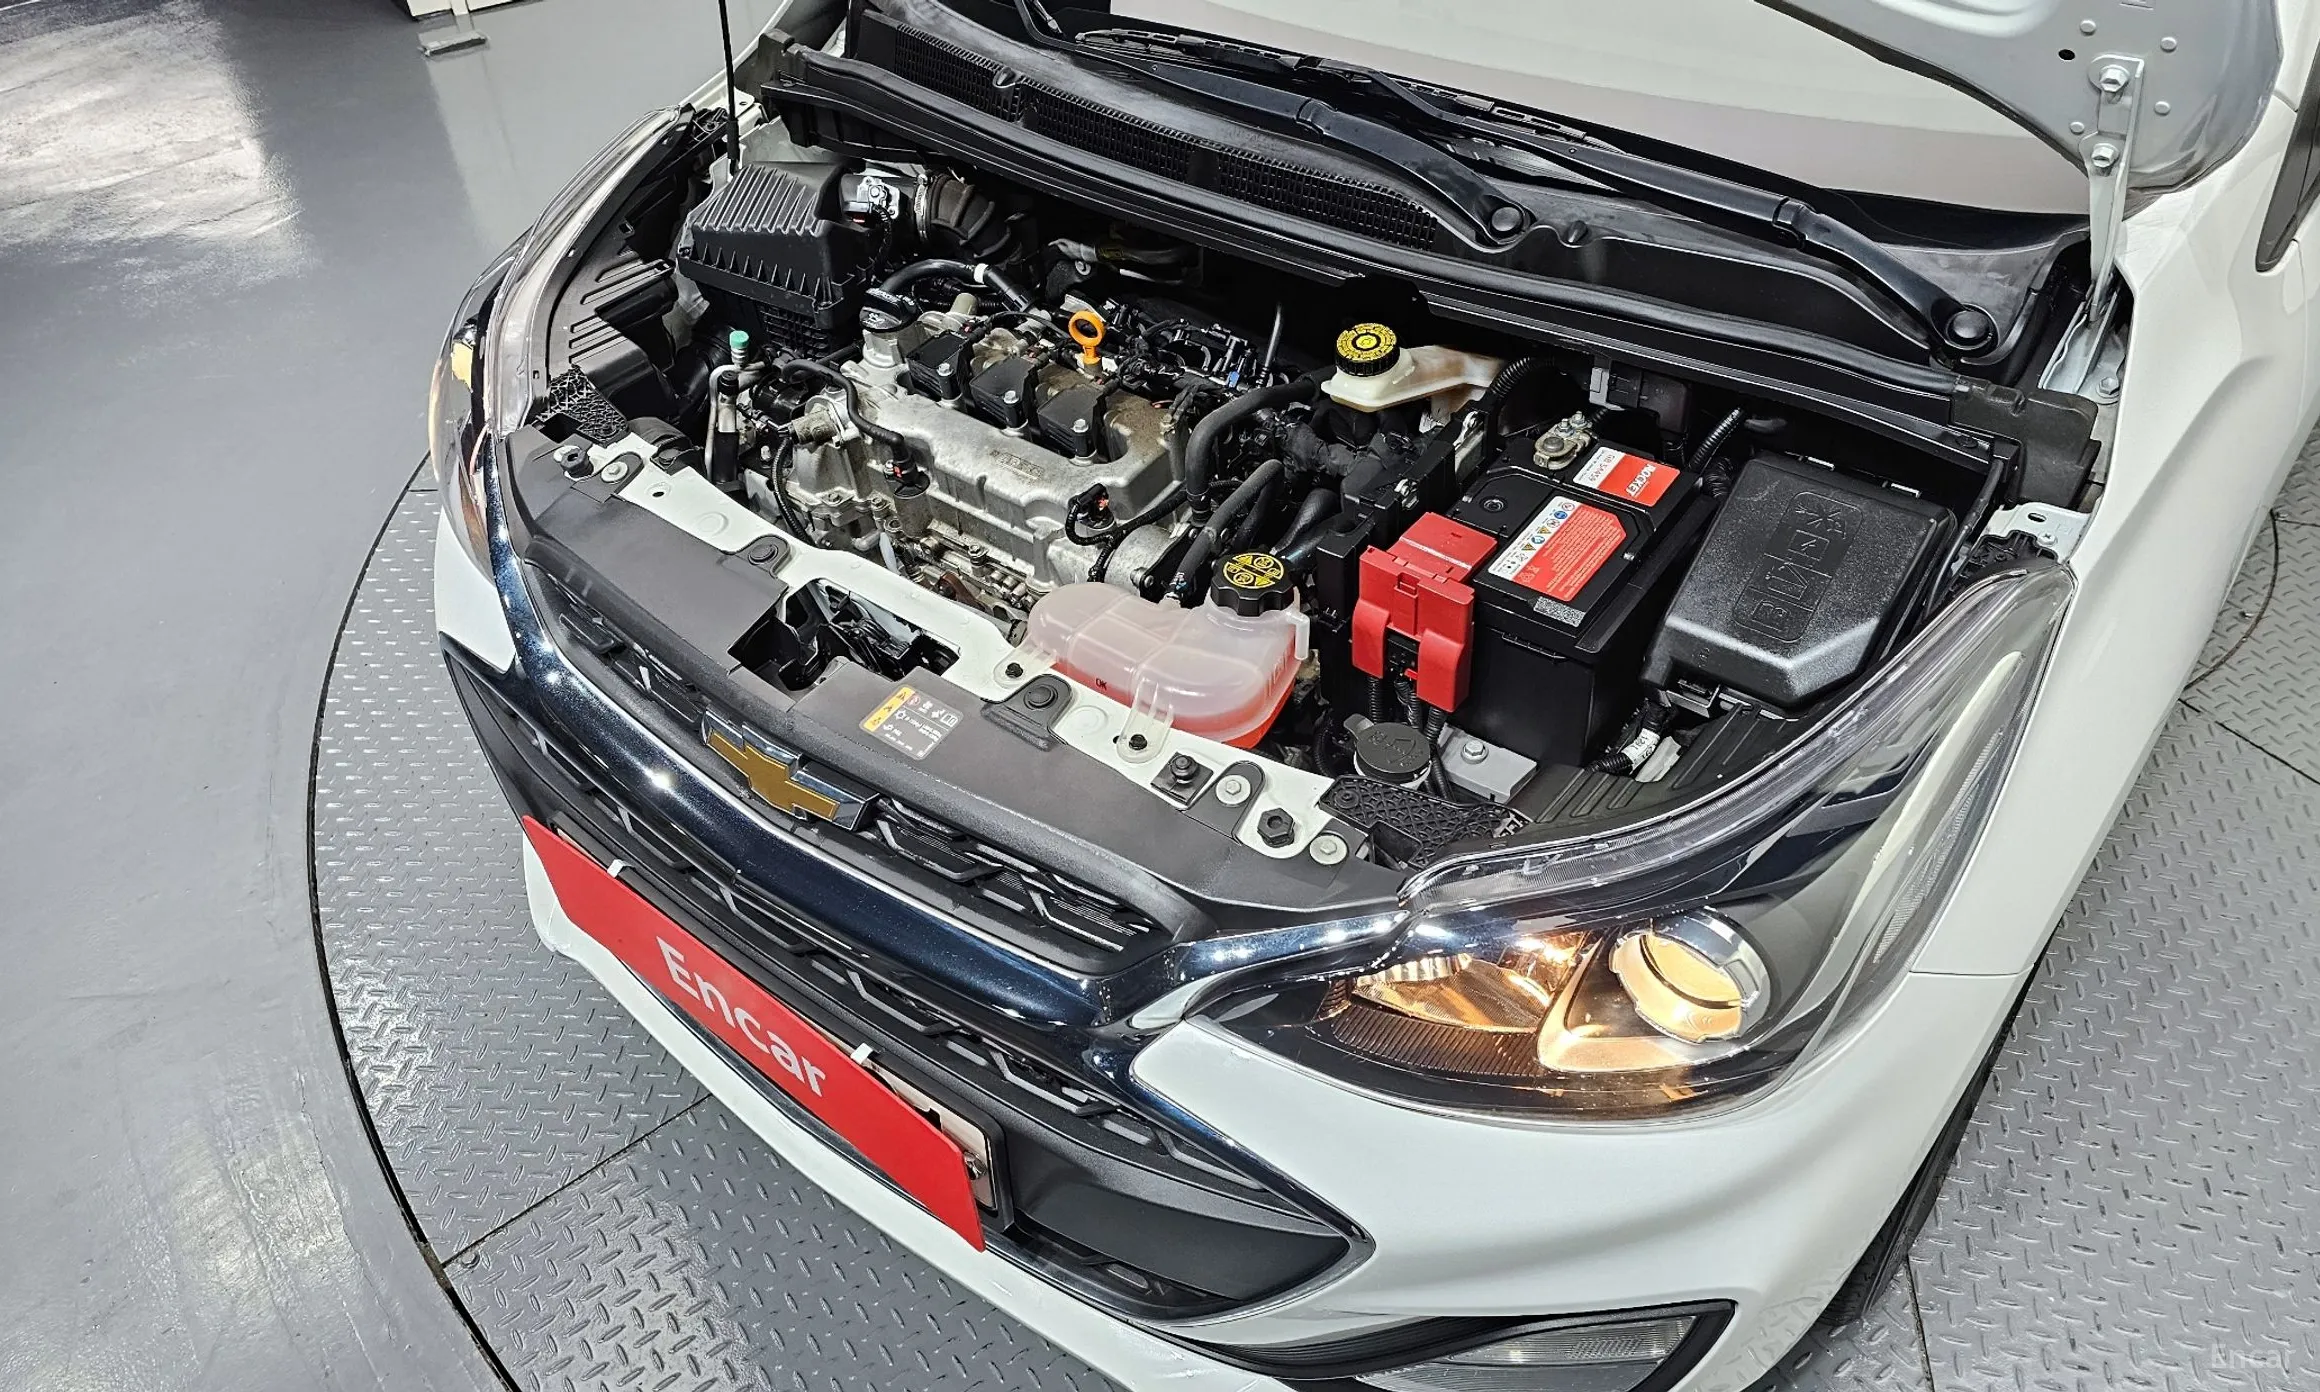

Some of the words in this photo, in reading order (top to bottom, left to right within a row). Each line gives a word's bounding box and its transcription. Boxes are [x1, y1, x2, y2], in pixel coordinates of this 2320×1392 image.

[1625, 463, 1657, 498] ROCKET
[1095, 677, 1108, 691] OK
[656, 935, 827, 1098] Encar
